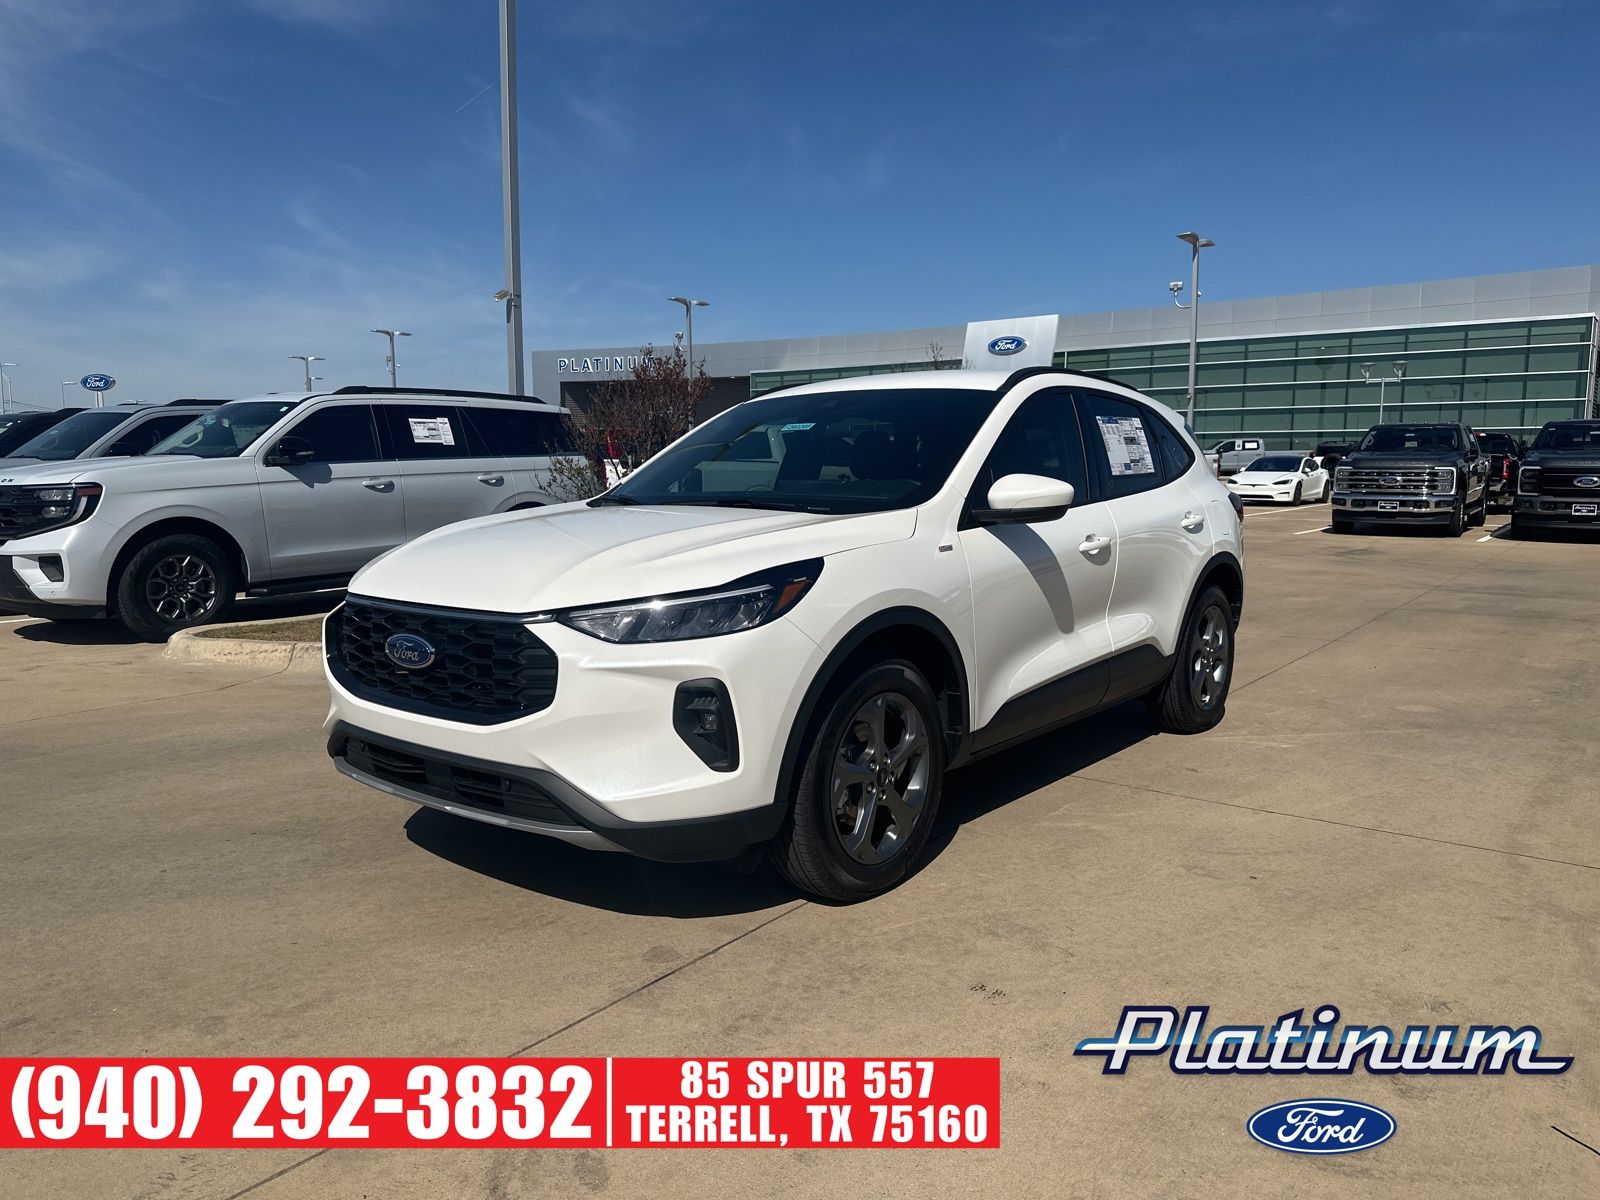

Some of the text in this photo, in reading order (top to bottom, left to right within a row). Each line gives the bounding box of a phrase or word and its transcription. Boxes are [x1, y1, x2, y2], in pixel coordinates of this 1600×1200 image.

[994, 339, 1018, 350] Ford
[86, 377, 105, 388] Ford
[393, 640, 425, 661] Ford
